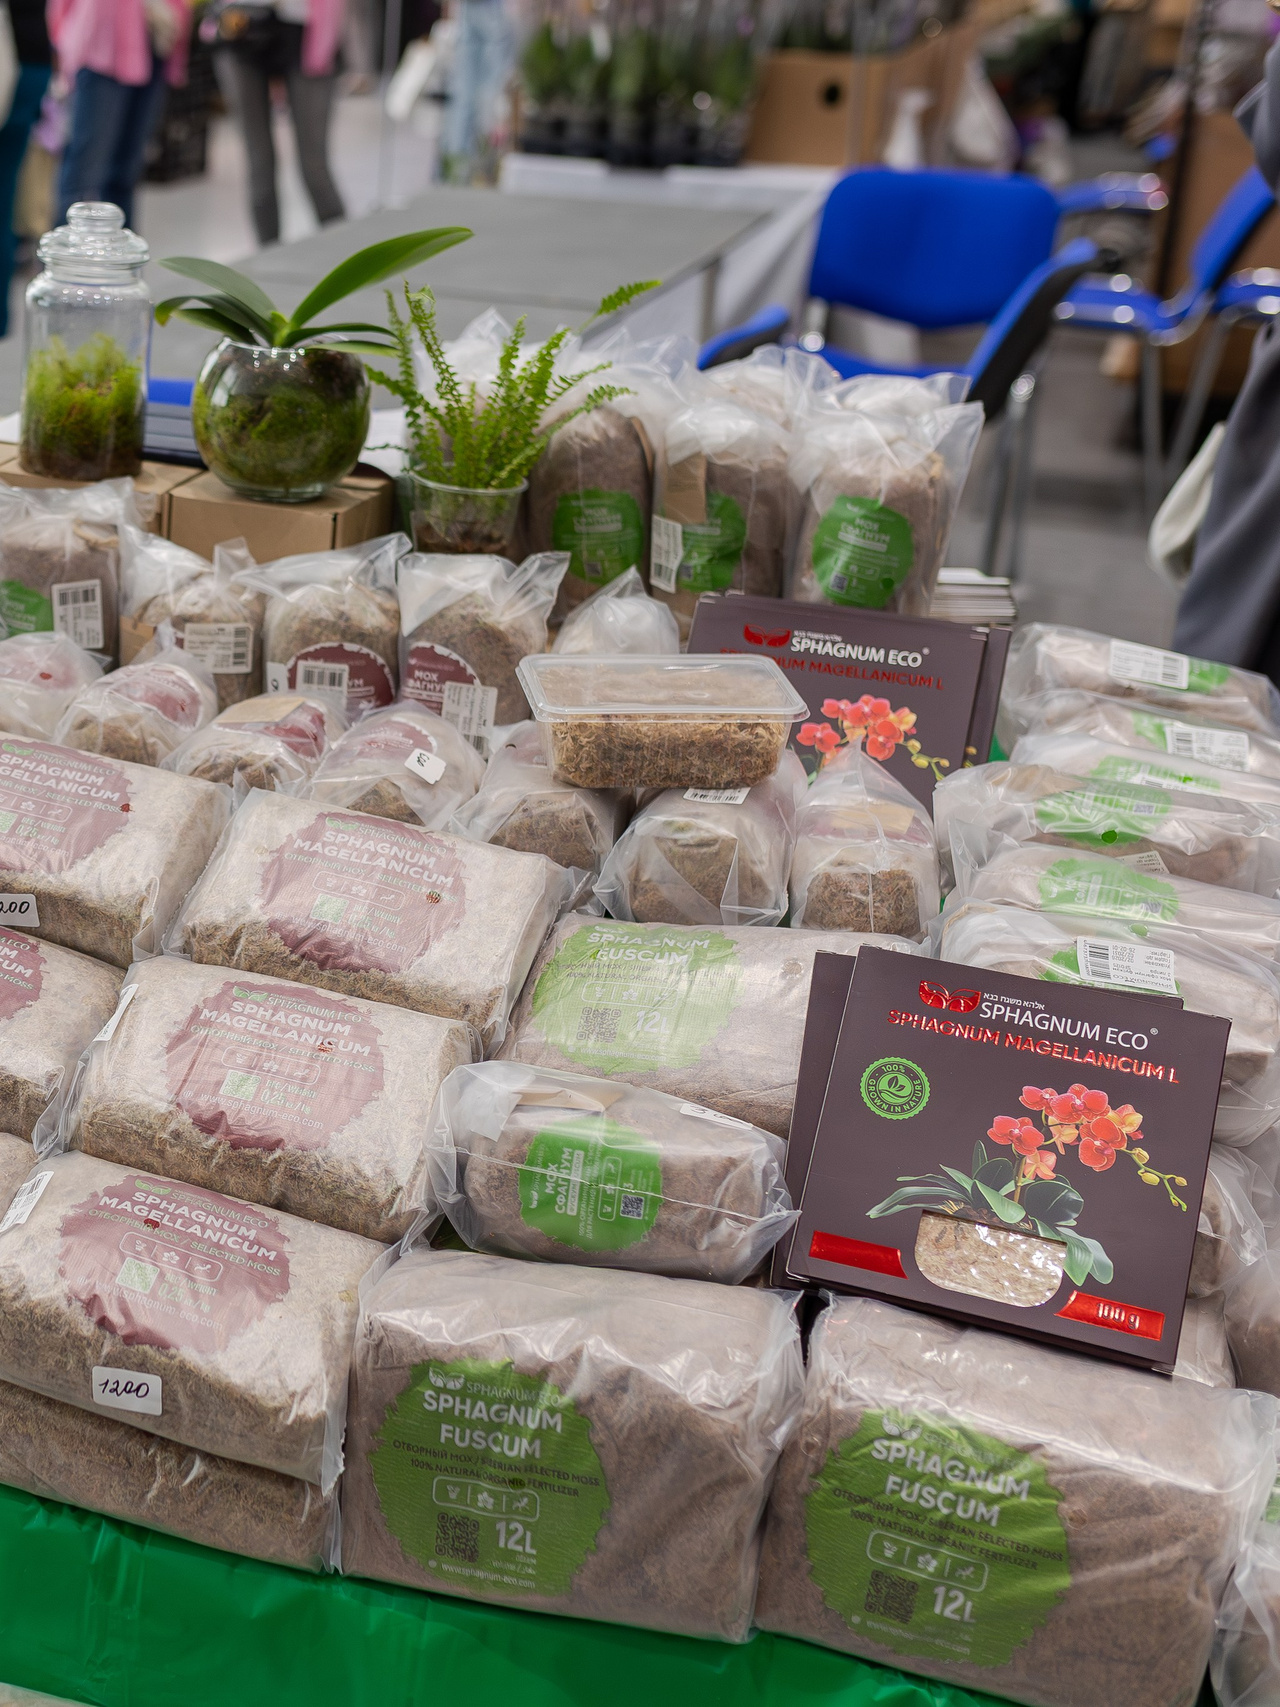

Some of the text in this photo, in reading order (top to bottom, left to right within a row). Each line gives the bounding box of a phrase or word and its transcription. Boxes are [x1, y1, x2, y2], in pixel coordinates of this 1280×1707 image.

[791, 636, 923, 667] SPHAGNUM ECO
[809, 662, 935, 688] MAGELLANICUM
[936, 677, 944, 690] L
[31, 751, 116, 776] SPHAGNUM ECO
[323, 831, 436, 869] SPHAGNUM
[357, 826, 447, 855] SPHAGNUM ECO
[294, 838, 454, 888] MAGELLANICUM
[8, 939, 31, 951] ECO
[586, 932, 710, 949] SPHAGNUM
[230, 1001, 351, 1036] SPHAGNUM
[266, 995, 362, 1024] SPHAGNUM ECO
[636, 1010, 670, 1034] 12L
[979, 1001, 1101, 1041] SPHAGNUM
[199, 1009, 371, 1056] MAGELLANICUM
[887, 1009, 1179, 1084] SPHAGNUM MAGELLANICUM L
[882, 1064, 905, 1073] 100%
[868, 1079, 888, 1110] GROWN
[903, 1079, 922, 1110] NATURE
[545, 1162, 559, 1194] МОХ
[554, 1147, 573, 1214] СФАГНУМ
[99, 1195, 277, 1261] MAGELLANICUM
[131, 1192, 257, 1241] SPHAGNUM
[170, 1192, 269, 1229] SPHAGNUM ECO
[1097, 1302, 1125, 1323] 100
[98, 1378, 150, 1399] 1200
[466, 1382, 538, 1401] SPHAGNUM
[423, 1390, 562, 1434] SPHAGNUM
[440, 1423, 542, 1460] FUSCUM
[393, 1439, 448, 1460] ОТБОРНЫЙ
[524, 1464, 570, 1481] SELECTED
[572, 1474, 600, 1487] MOSS
[435, 1463, 481, 1480] NATURAL
[527, 1478, 579, 1497] FERTILIZER
[870, 1438, 1030, 1501] SPHAGNUM
[885, 1474, 1000, 1528] FUSCUM
[495, 1521, 537, 1556] 12L
[933, 1585, 976, 1623] 12L
